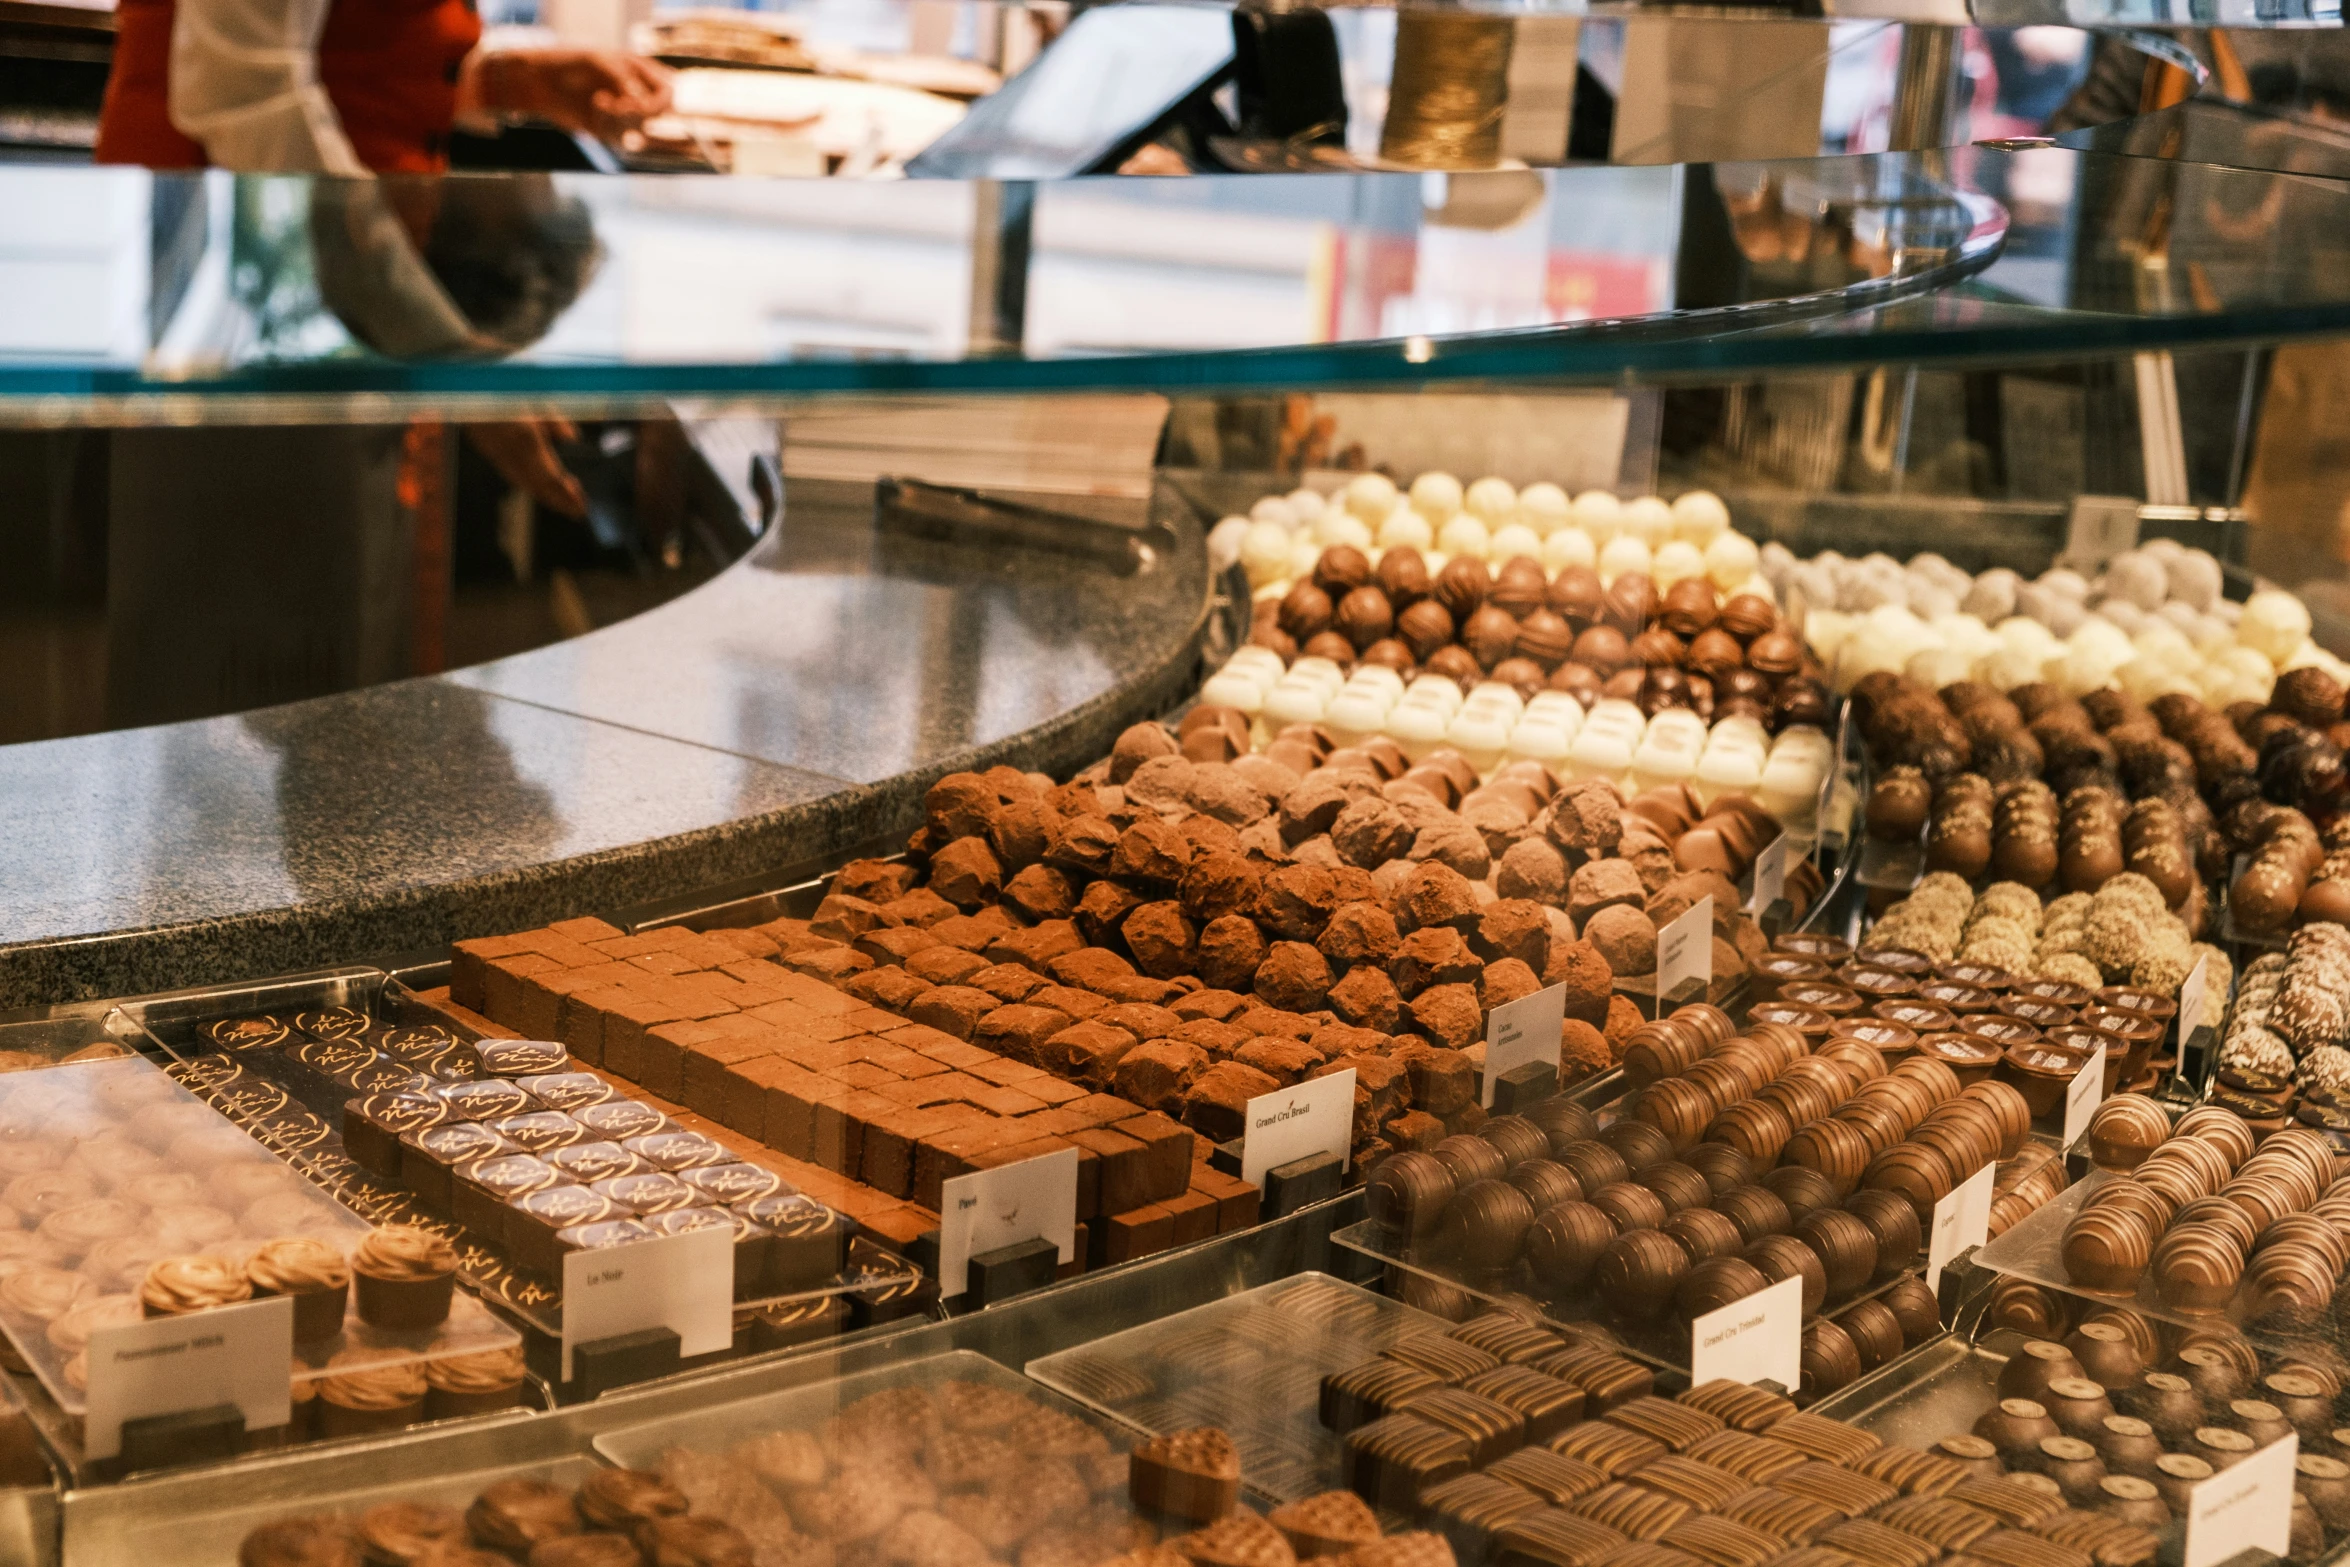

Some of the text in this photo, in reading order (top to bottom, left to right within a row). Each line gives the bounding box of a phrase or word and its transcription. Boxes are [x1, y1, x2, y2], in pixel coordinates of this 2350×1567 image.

[1255, 1103, 1311, 1129] Grand Cru Brasil
[1703, 1330, 1724, 1349] Grand
[1725, 1326, 1738, 1340] Cru
